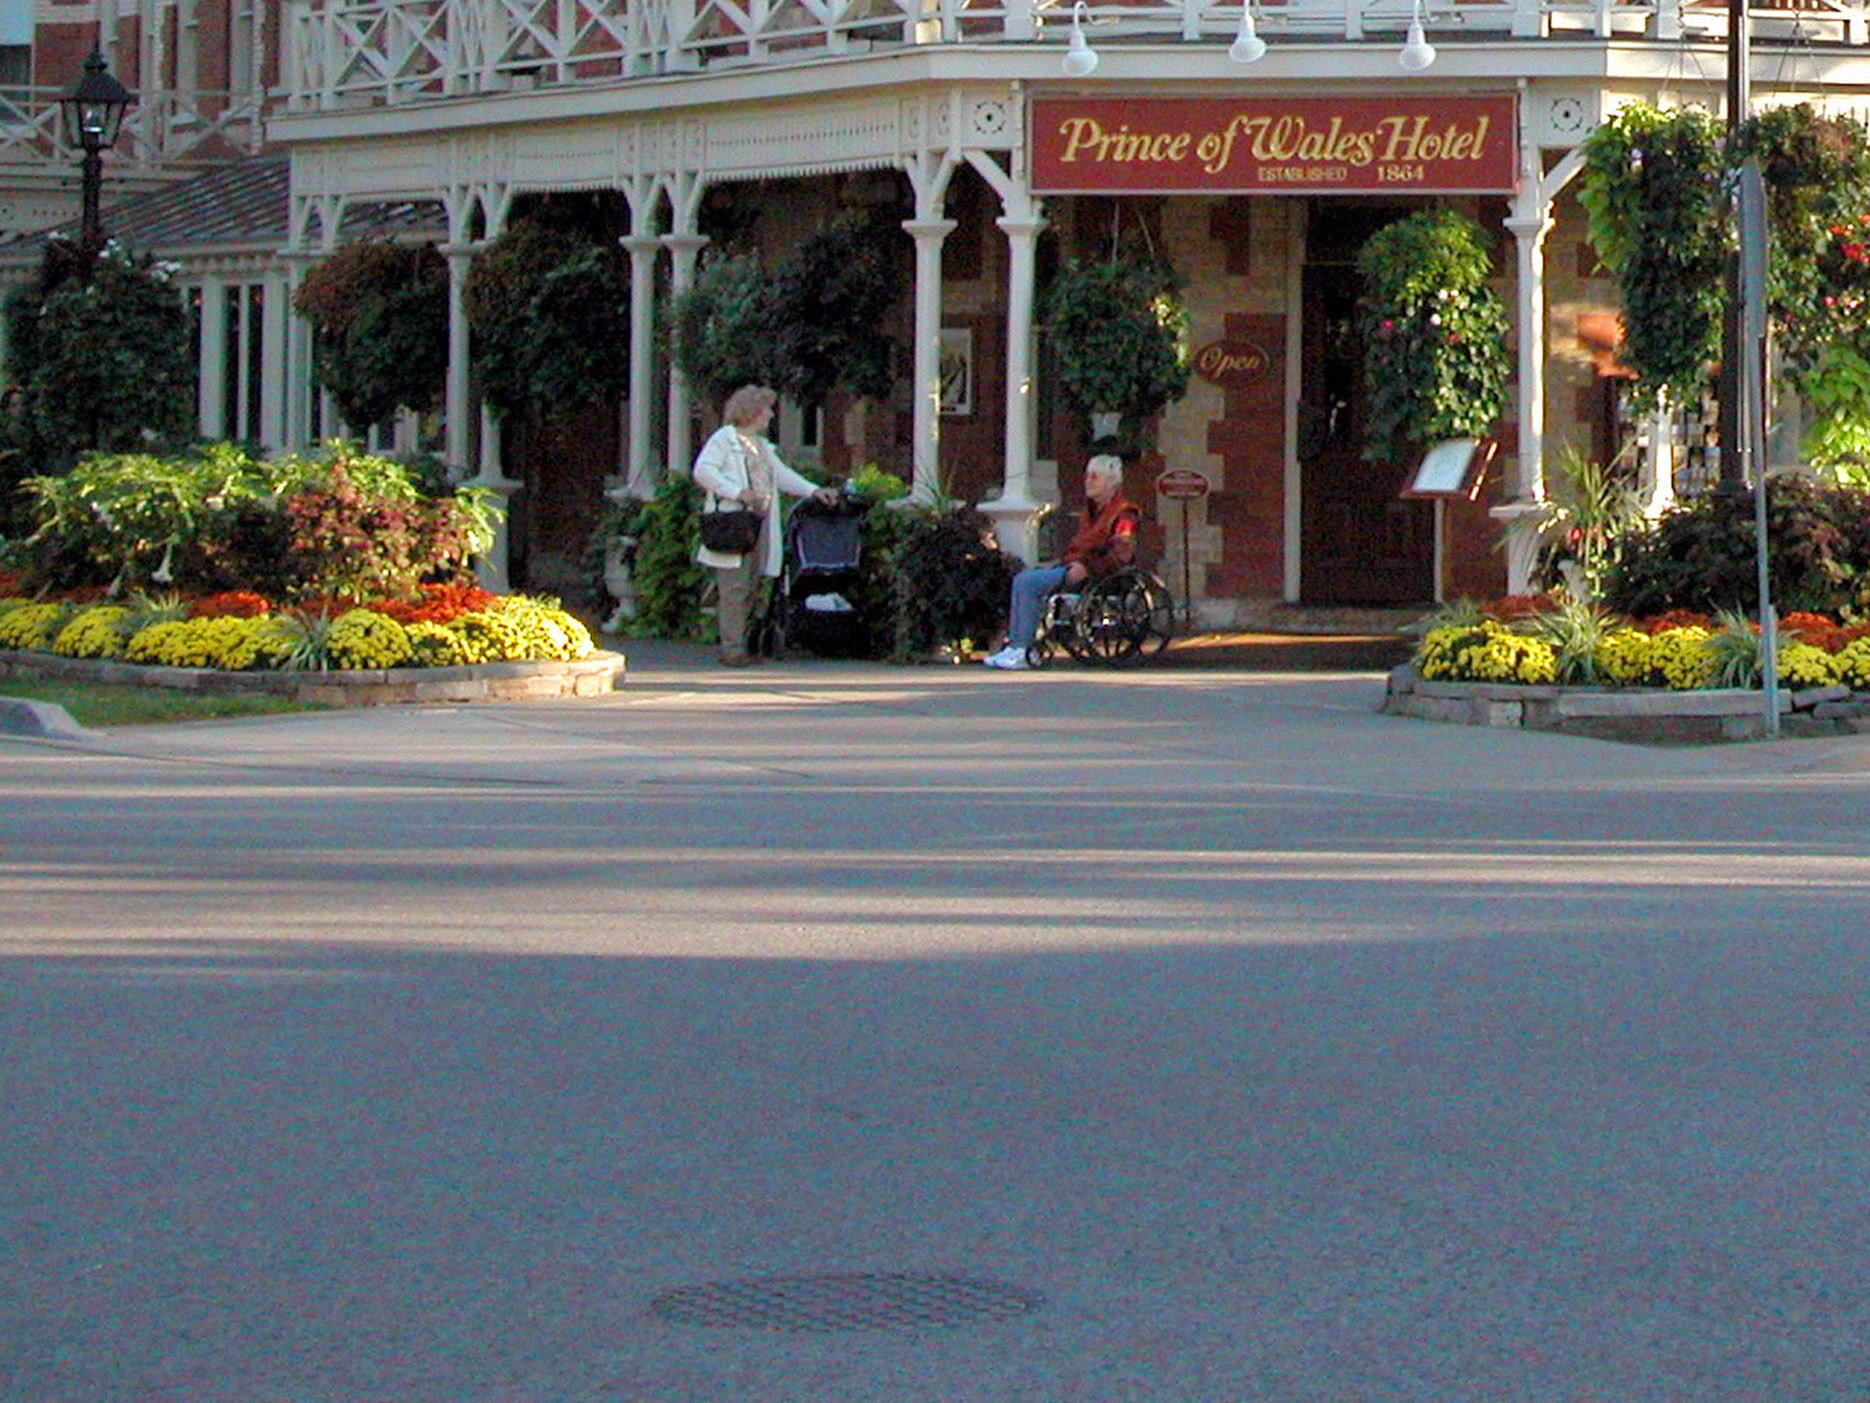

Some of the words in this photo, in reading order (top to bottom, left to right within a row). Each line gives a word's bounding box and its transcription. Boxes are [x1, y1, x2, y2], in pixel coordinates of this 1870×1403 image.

[1059, 117, 1188, 163] Prince
[1197, 114, 1249, 174] of
[1244, 115, 1375, 168] Wales
[1376, 115, 1490, 162] Hotel
[1257, 166, 1348, 182] ESTABLISHED
[1377, 164, 1425, 182] 1864
[1200, 345, 1261, 379] Open
